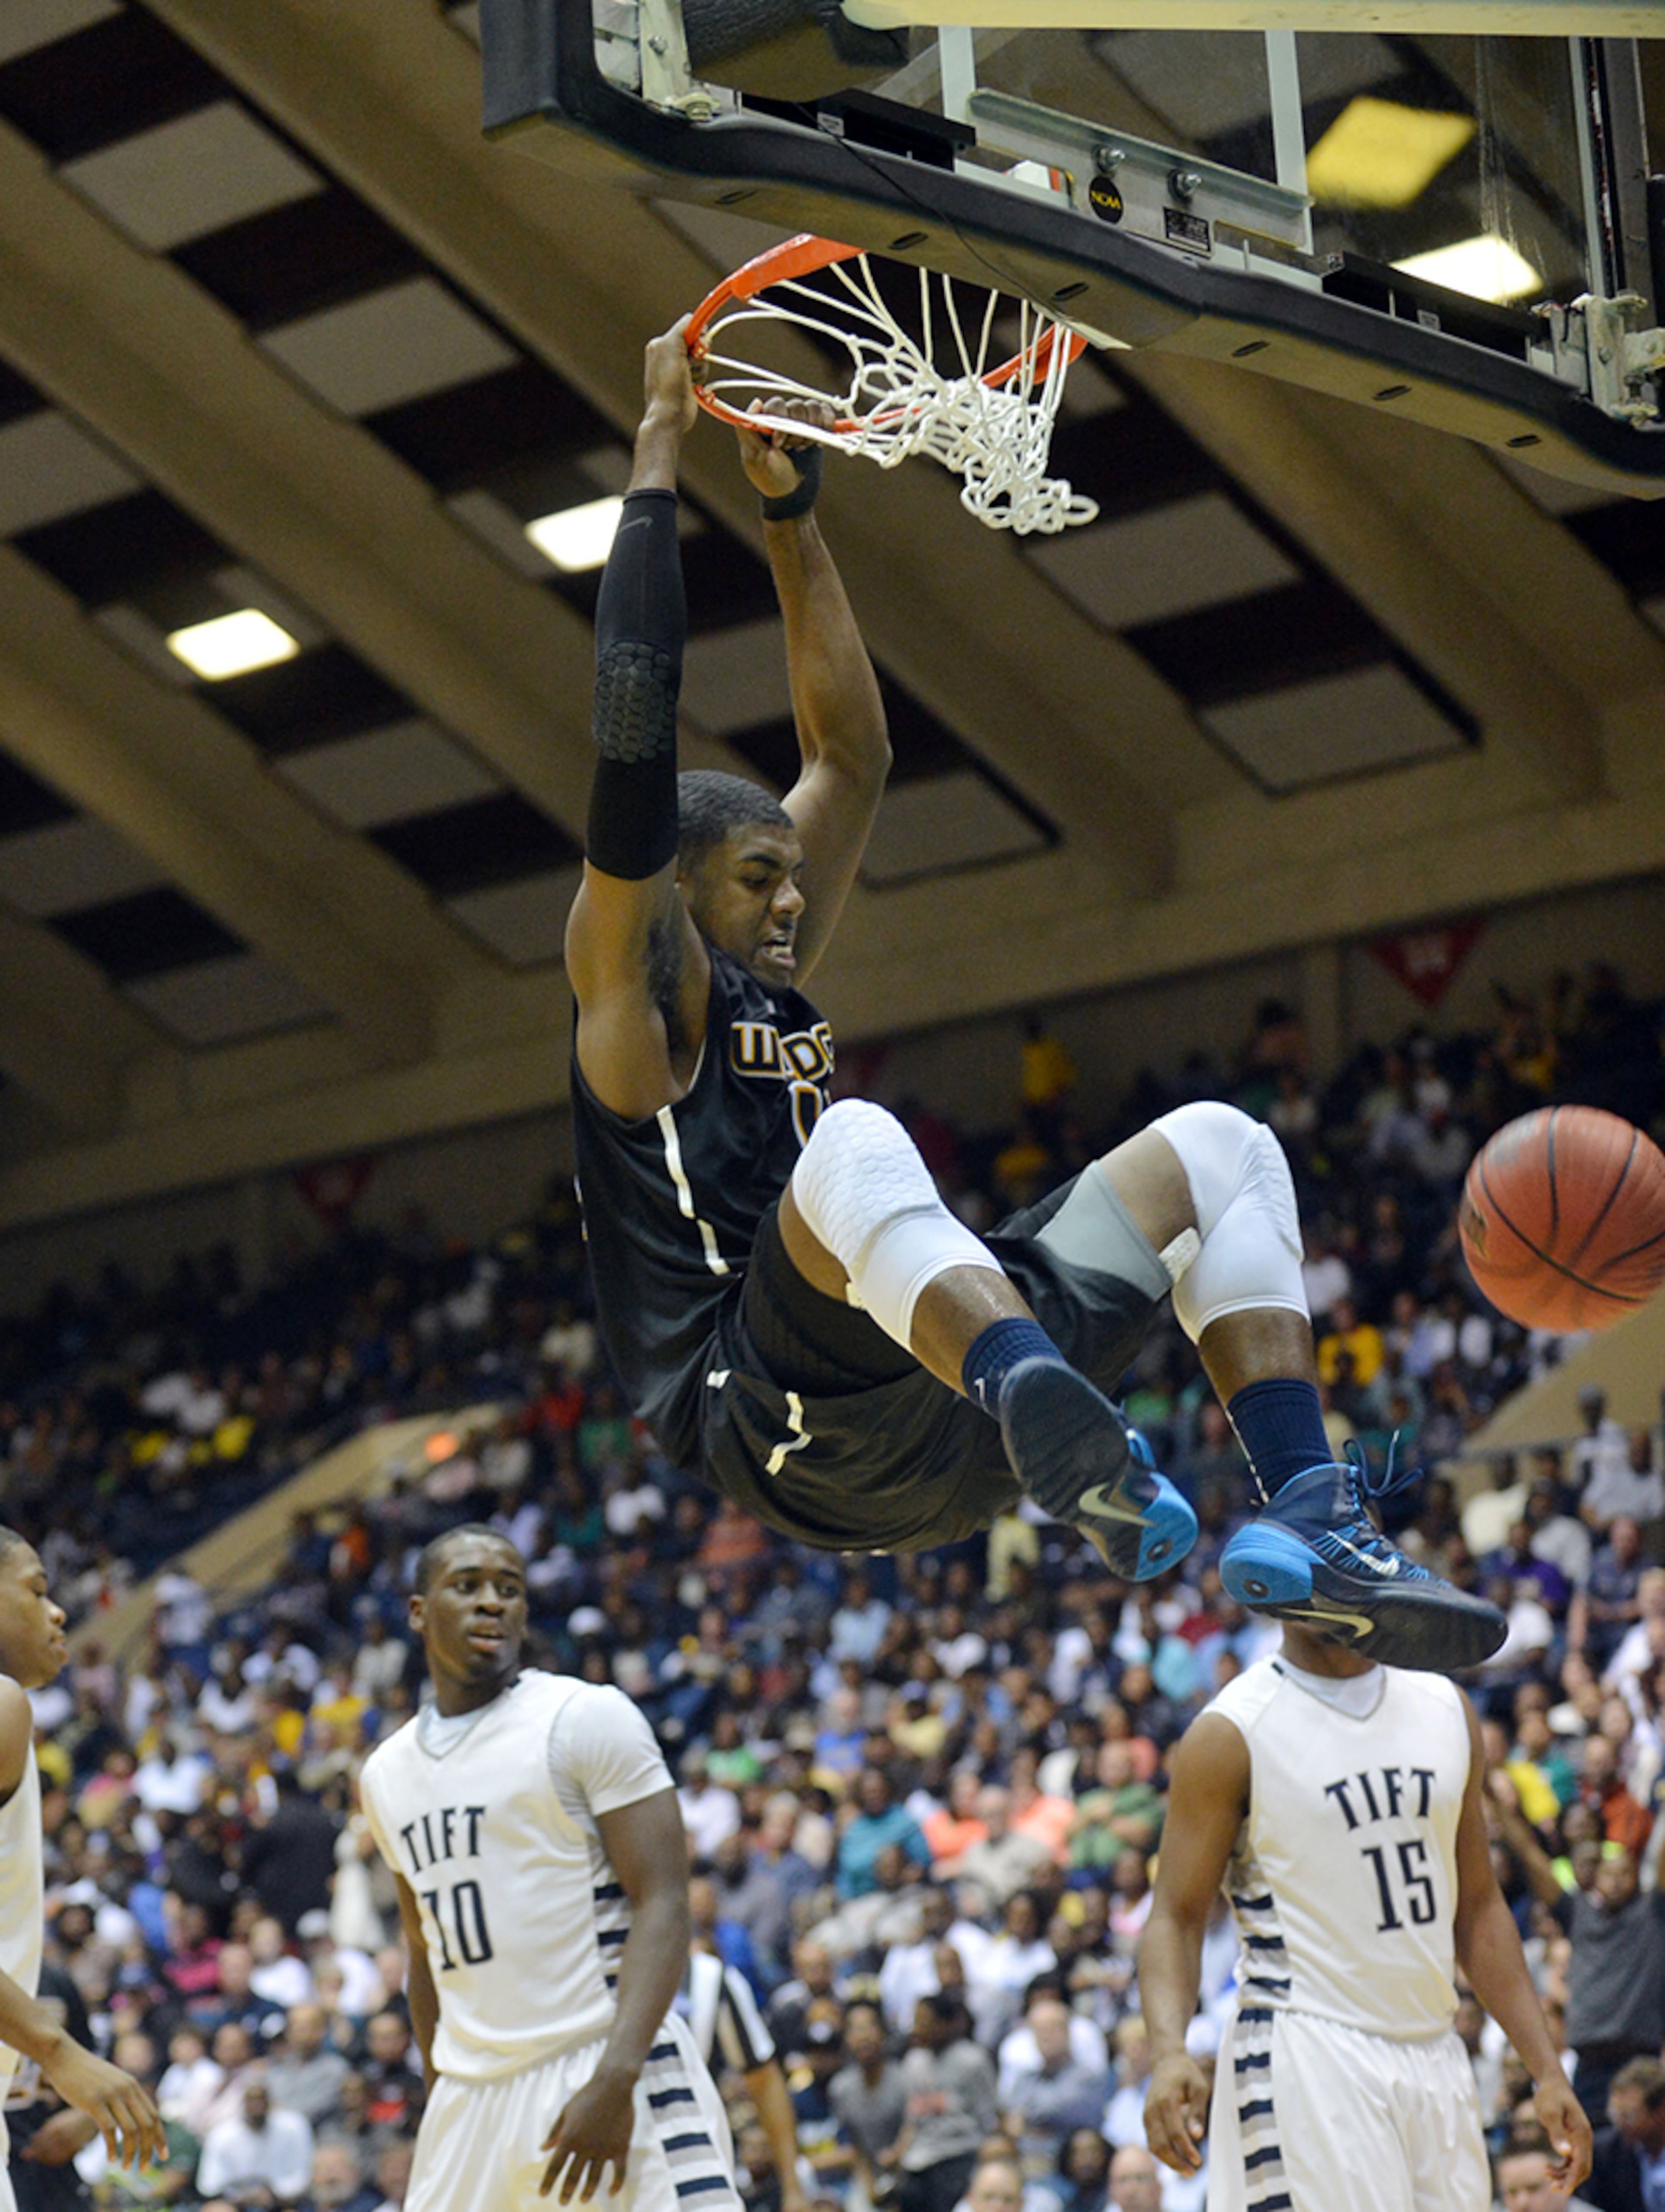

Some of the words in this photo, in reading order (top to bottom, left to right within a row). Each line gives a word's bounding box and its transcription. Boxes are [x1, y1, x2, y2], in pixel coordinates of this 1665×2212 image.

[1324, 1767, 1436, 1831] TIFT
[400, 1805, 487, 1874] TIFT
[421, 1880, 493, 1971] 10
[1361, 1839, 1436, 1933] 15
